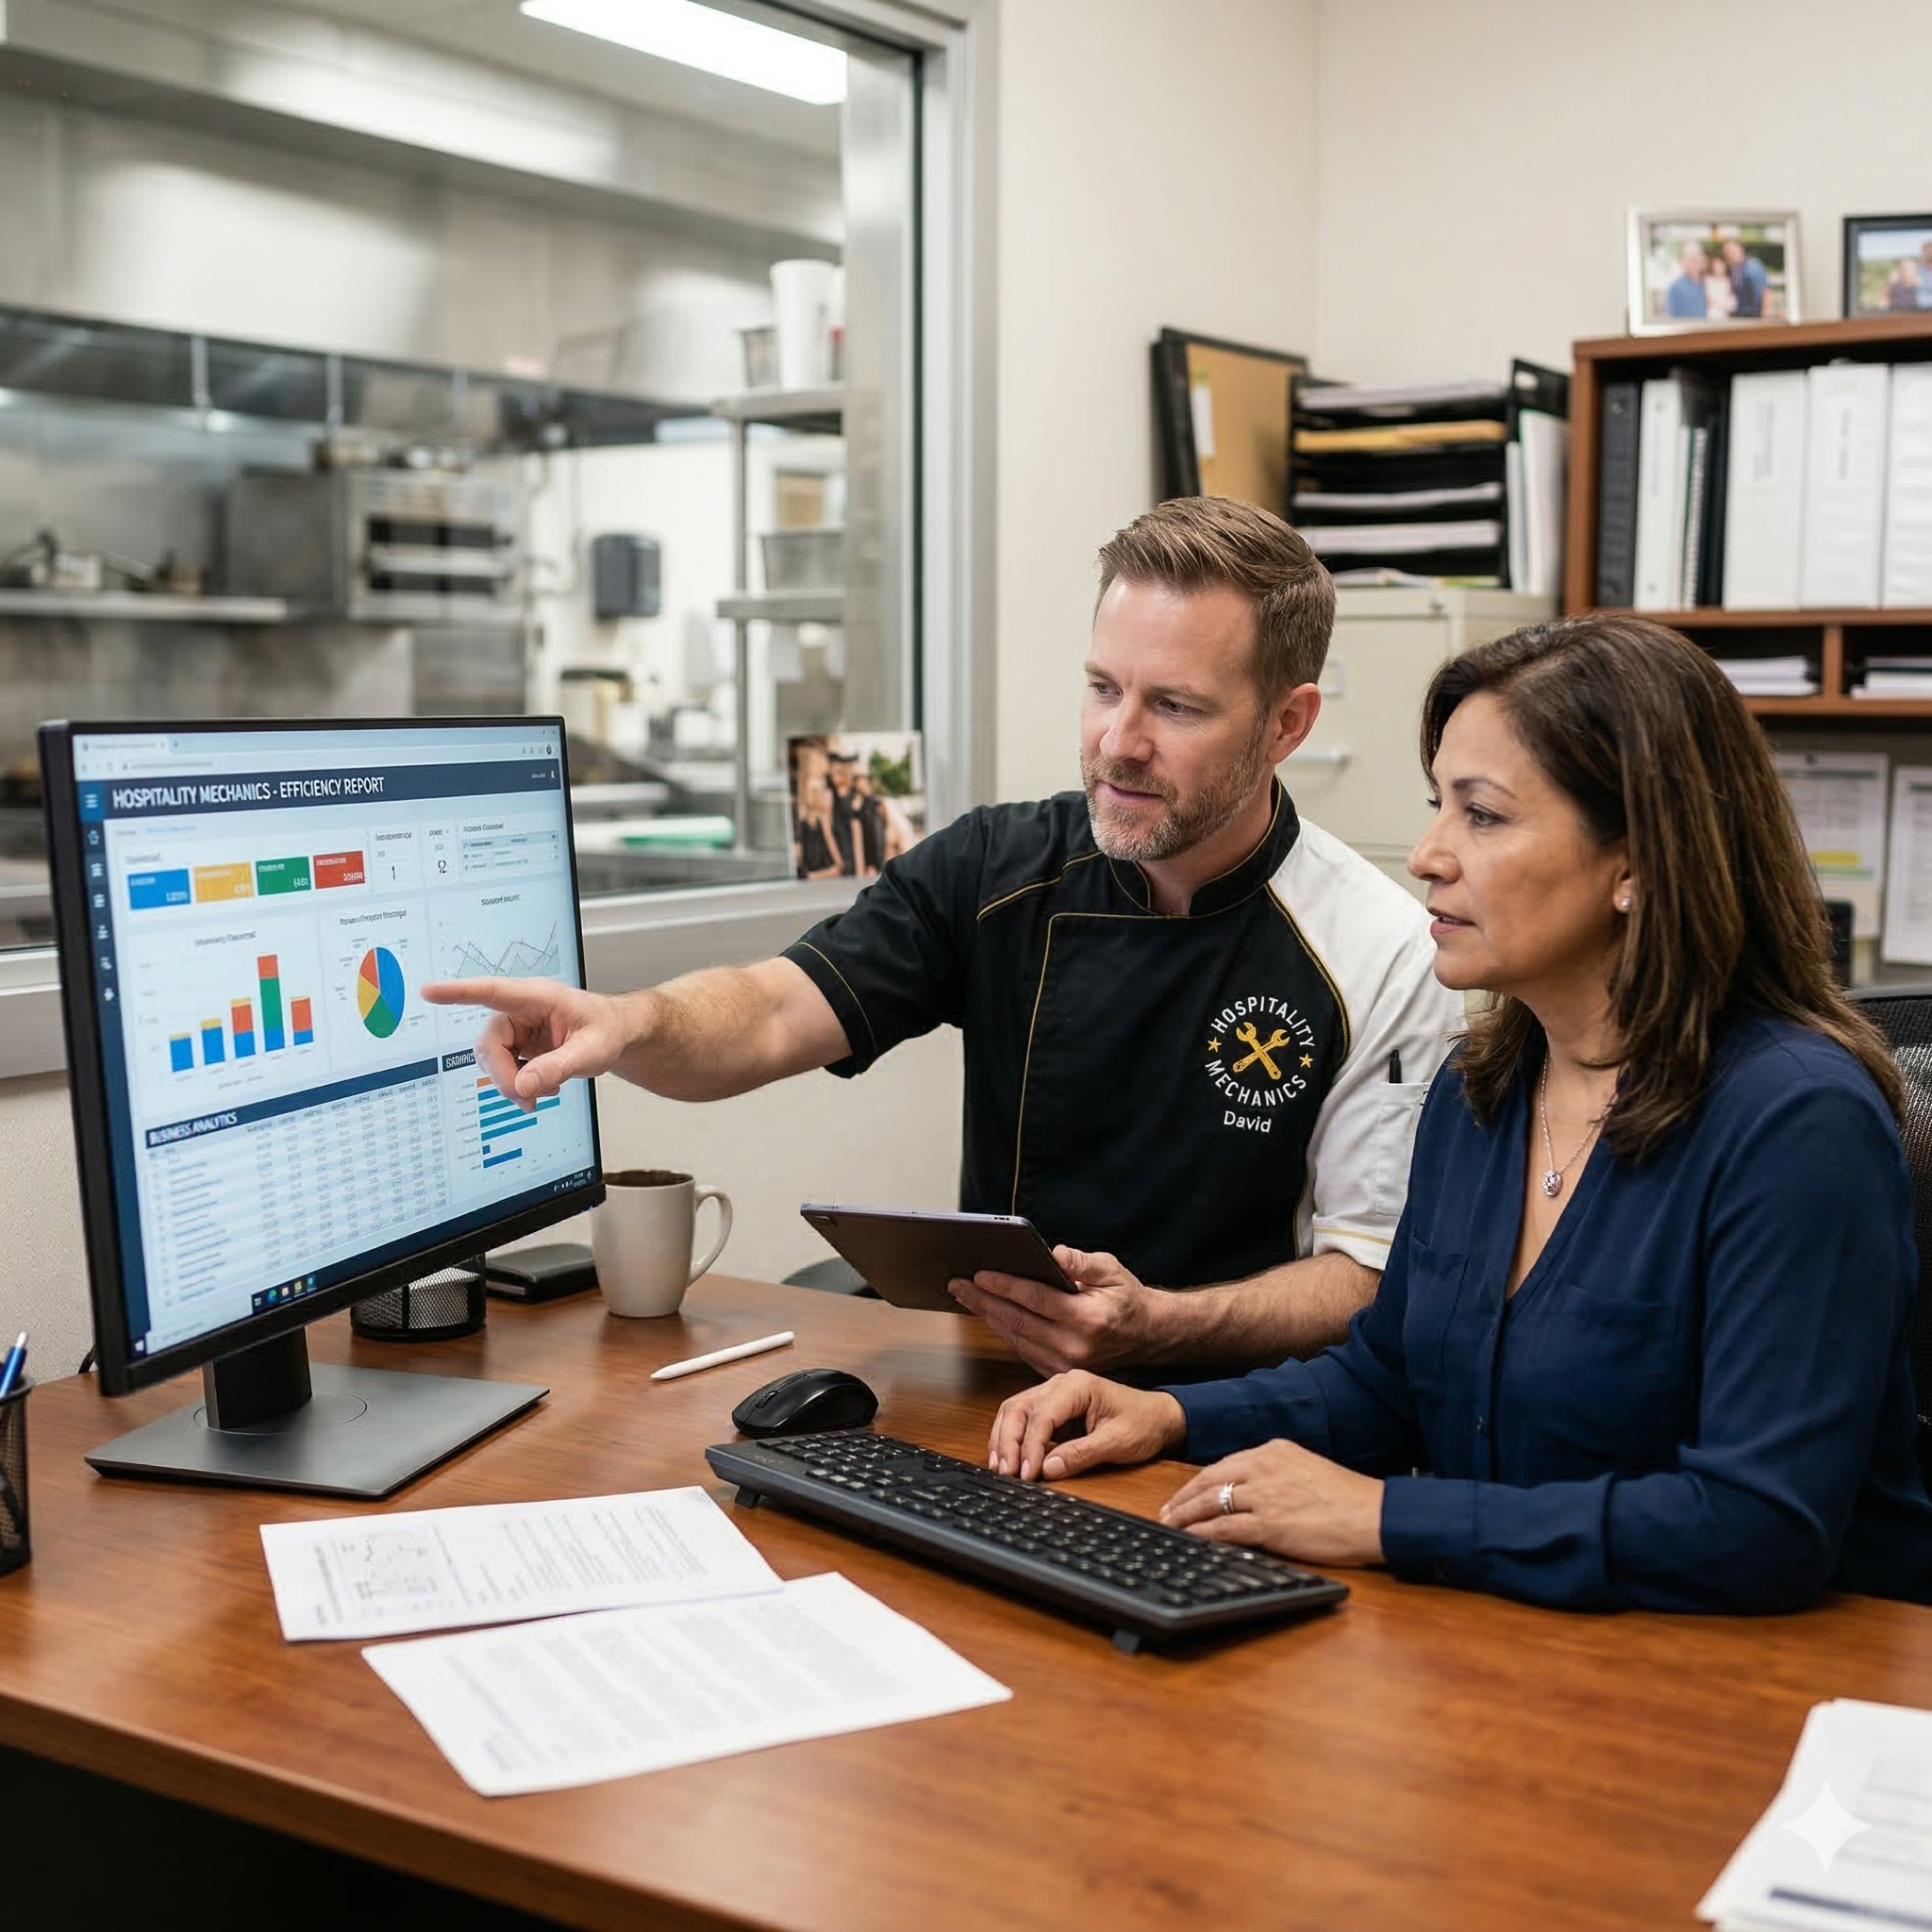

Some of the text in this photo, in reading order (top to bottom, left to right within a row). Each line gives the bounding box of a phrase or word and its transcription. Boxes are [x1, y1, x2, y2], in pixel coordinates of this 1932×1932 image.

[112, 786, 196, 809] HOSPITALITY
[199, 782, 271, 804] MECHANICS
[279, 778, 341, 798] EFFICIENCY
[343, 776, 384, 795] REPORT
[1210, 996, 1315, 1047] HOSPITALITY
[1205, 1059, 1307, 1107] MECHANICS
[1224, 1110, 1272, 1133] David
